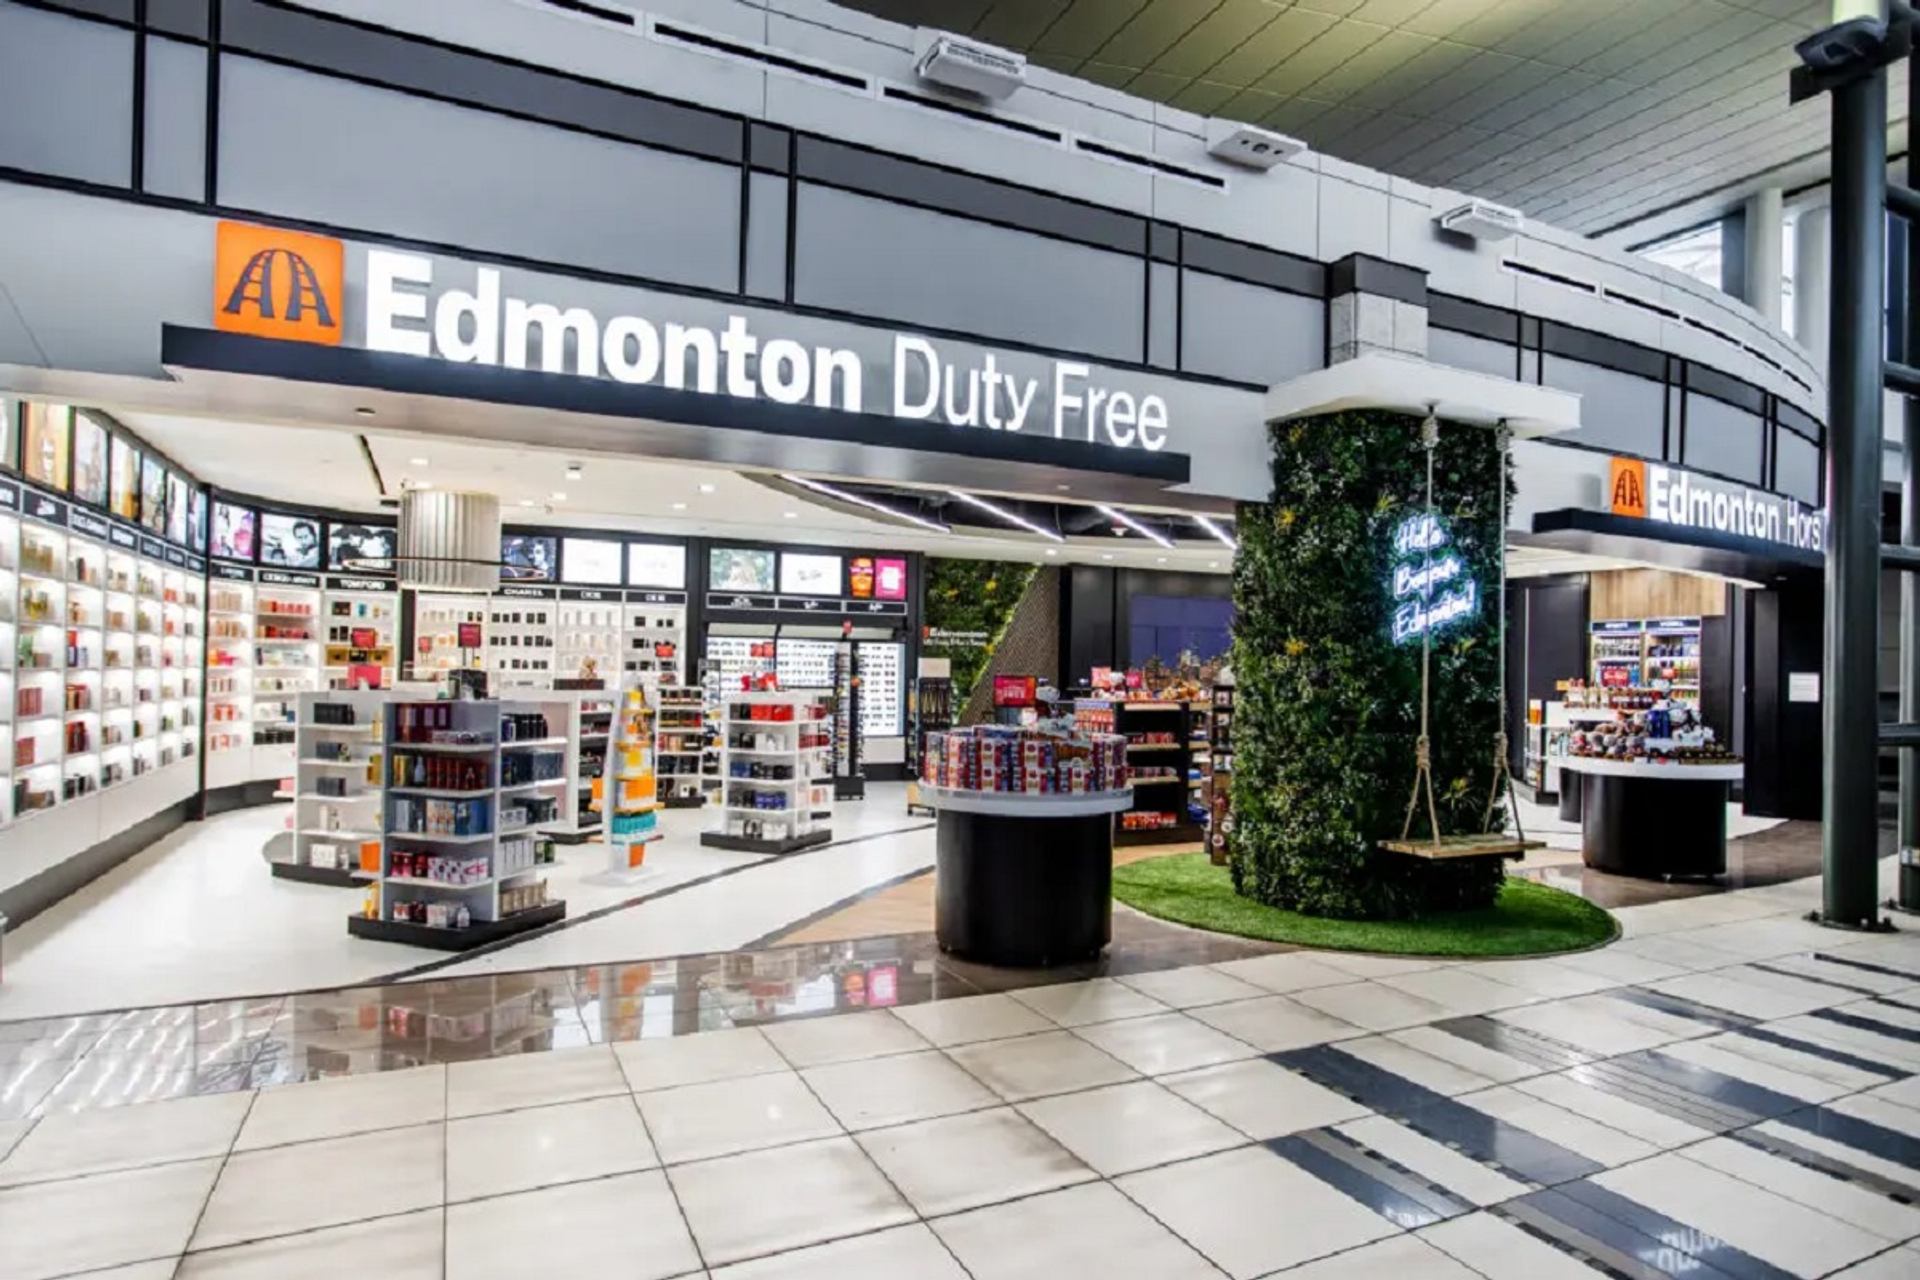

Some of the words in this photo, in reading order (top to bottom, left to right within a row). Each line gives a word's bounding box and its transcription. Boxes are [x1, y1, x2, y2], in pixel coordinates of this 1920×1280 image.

[366, 249, 862, 412] Edmonton
[893, 335, 1036, 434] Duty
[1055, 363, 1169, 452] Free
[1649, 463, 1780, 542] Edmonton
[1786, 496, 1822, 551] Hors
